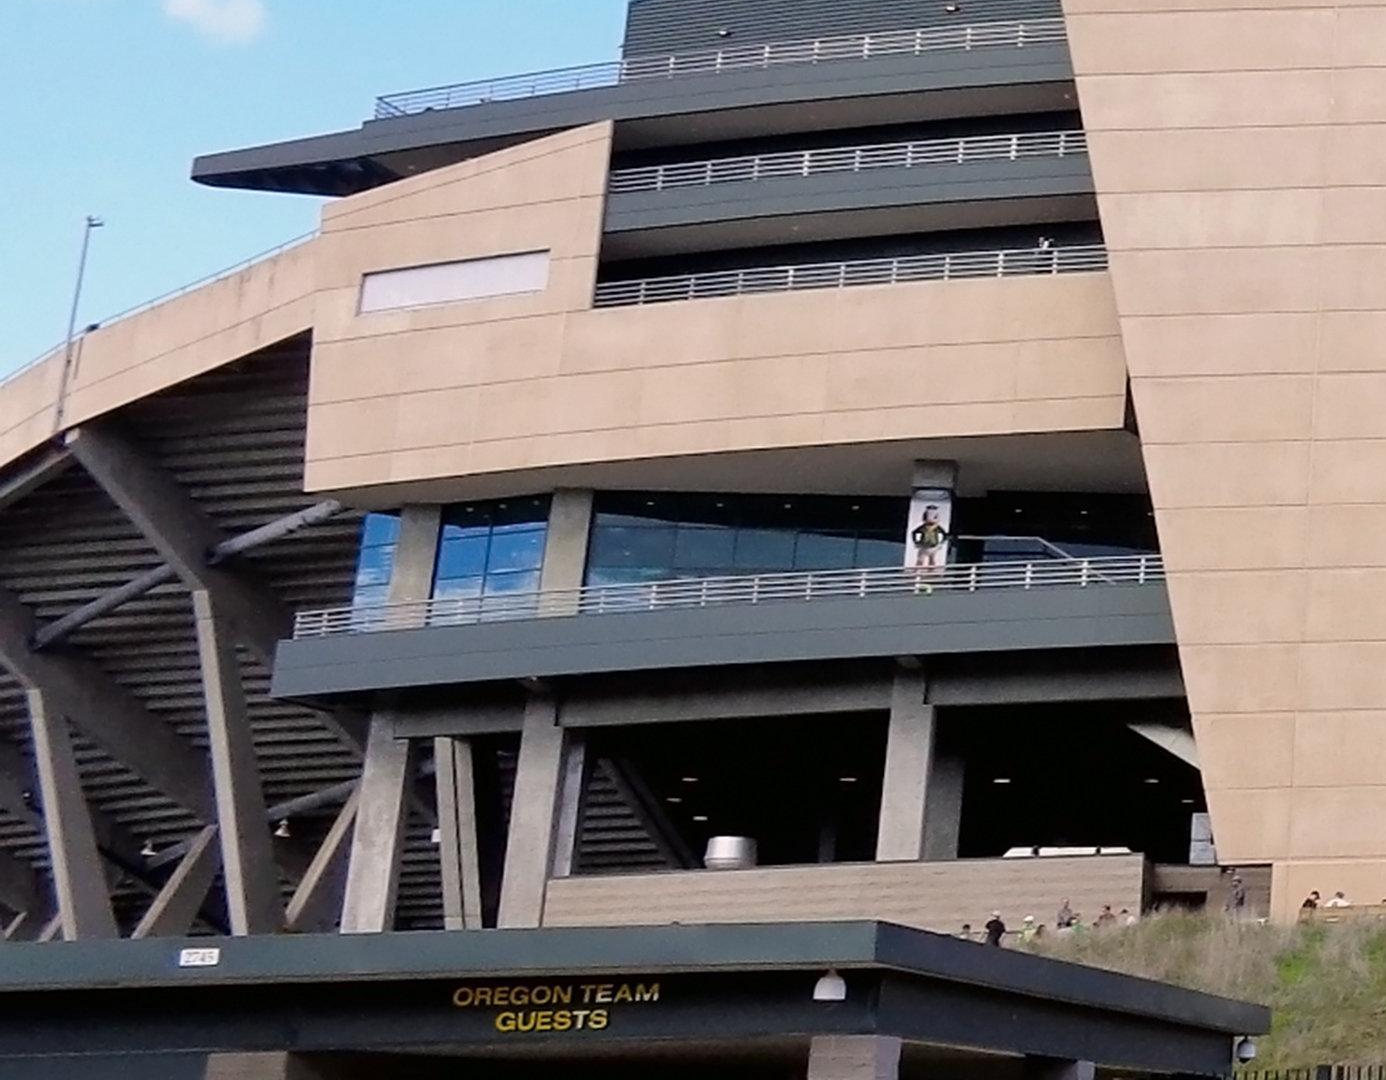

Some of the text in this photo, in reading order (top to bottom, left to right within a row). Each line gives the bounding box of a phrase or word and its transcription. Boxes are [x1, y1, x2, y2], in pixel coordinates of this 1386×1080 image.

[453, 983, 661, 1006] OREGON TEAM
[495, 1010, 609, 1032] GUESTS
